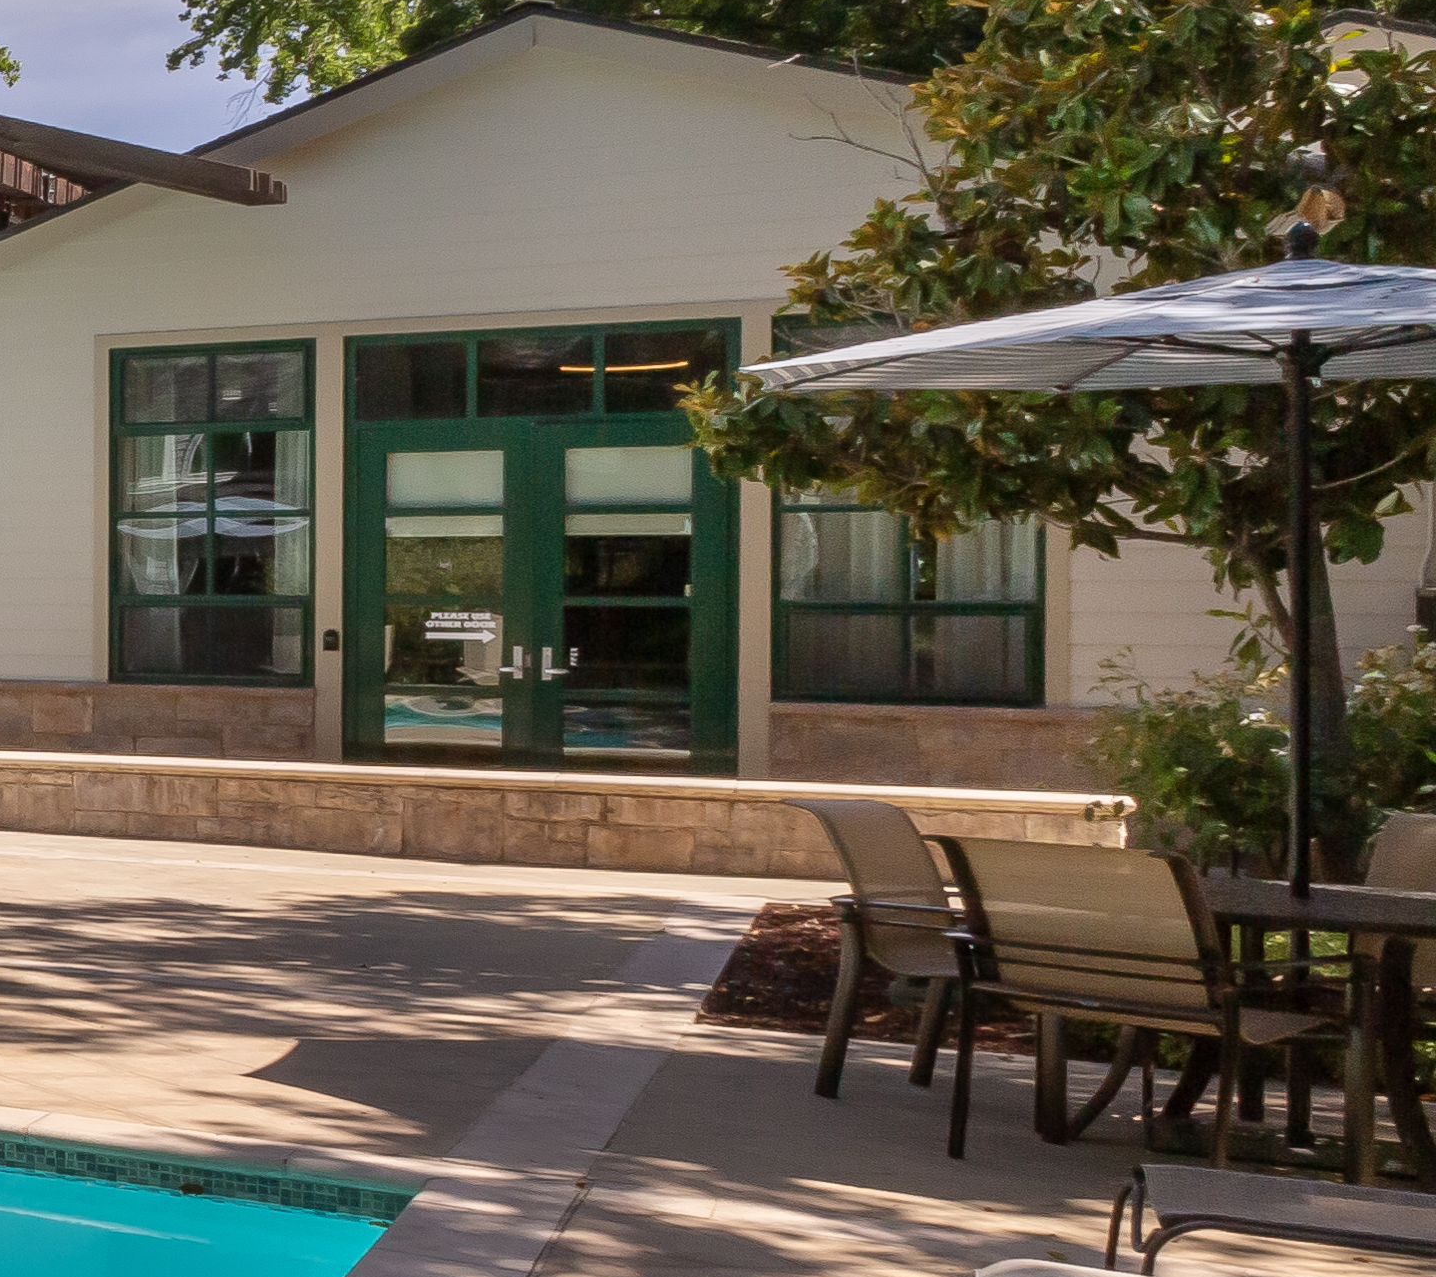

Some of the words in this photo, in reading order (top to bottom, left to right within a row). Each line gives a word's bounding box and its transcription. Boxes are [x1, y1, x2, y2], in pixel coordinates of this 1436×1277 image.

[431, 612, 470, 620] PLEASE
[471, 612, 492, 620] USE
[425, 620, 462, 628] OTHER
[463, 621, 497, 629] DOOR
